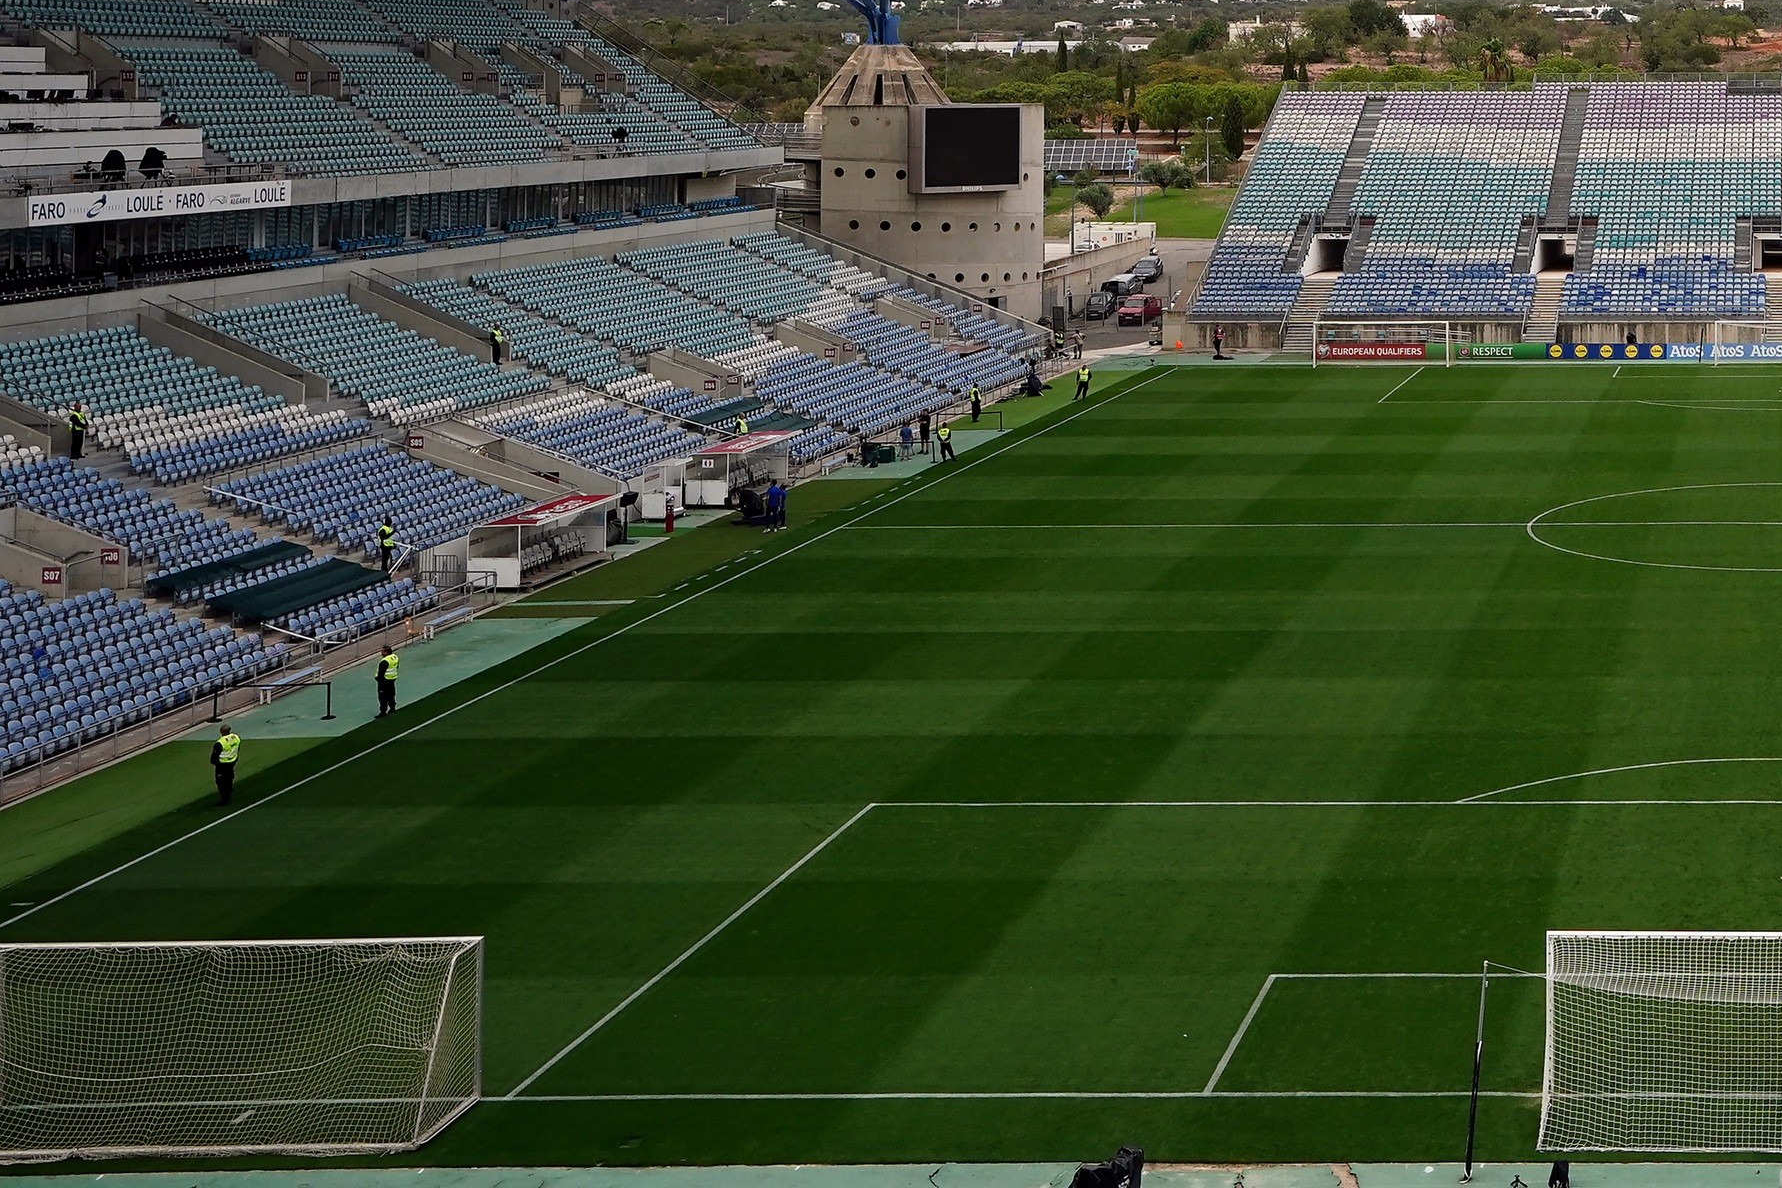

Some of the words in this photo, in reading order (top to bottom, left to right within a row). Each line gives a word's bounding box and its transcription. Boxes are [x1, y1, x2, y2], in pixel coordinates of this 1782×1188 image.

[31, 201, 66, 220] FARO
[126, 190, 164, 212] LOULÉ
[176, 192, 205, 209] FARO
[1332, 347, 1375, 356] EUROPEAN
[1376, 347, 1423, 357] QUALIFIERS
[1472, 347, 1513, 356] RESPECT
[43, 570, 60, 581] S07
